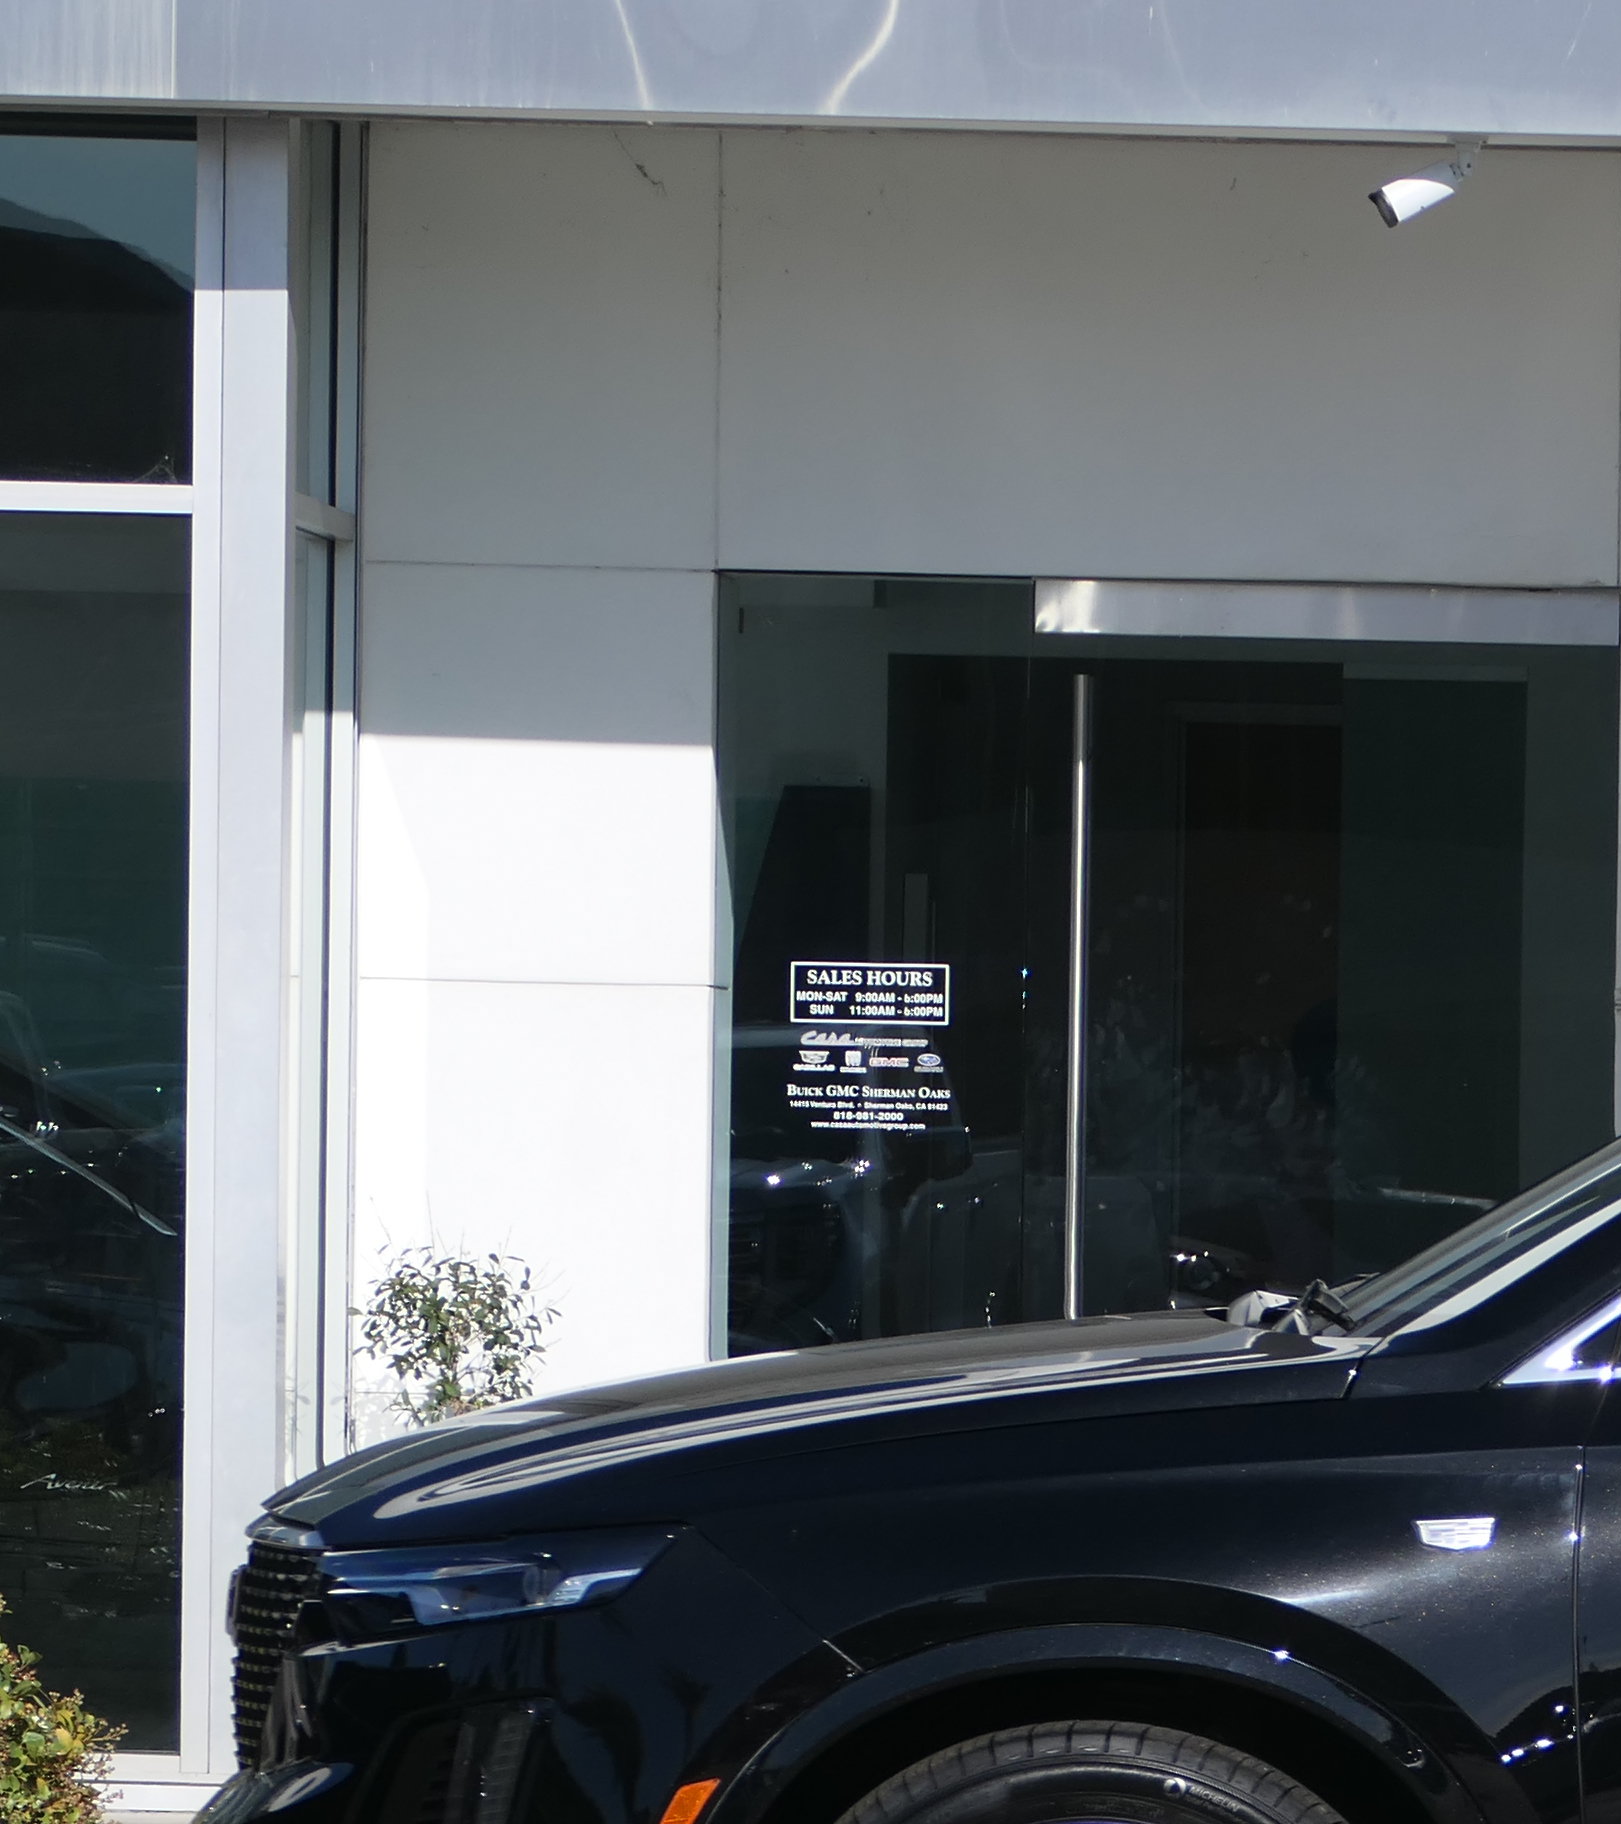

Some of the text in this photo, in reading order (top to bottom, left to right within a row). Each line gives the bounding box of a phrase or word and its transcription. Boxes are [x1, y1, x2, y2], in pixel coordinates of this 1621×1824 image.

[806, 969, 934, 987] SALES HOURS
[796, 991, 848, 1002] MON-SAT
[854, 992, 895, 1003] 9:00AM
[809, 1004, 834, 1015] SUN
[849, 1005, 895, 1016] 11:00AM
[869, 1057, 910, 1068] GMC
[826, 1084, 860, 1097] GMC
[862, 1085, 916, 1099] SHERMAN
[915, 1102, 927, 1110] CA
